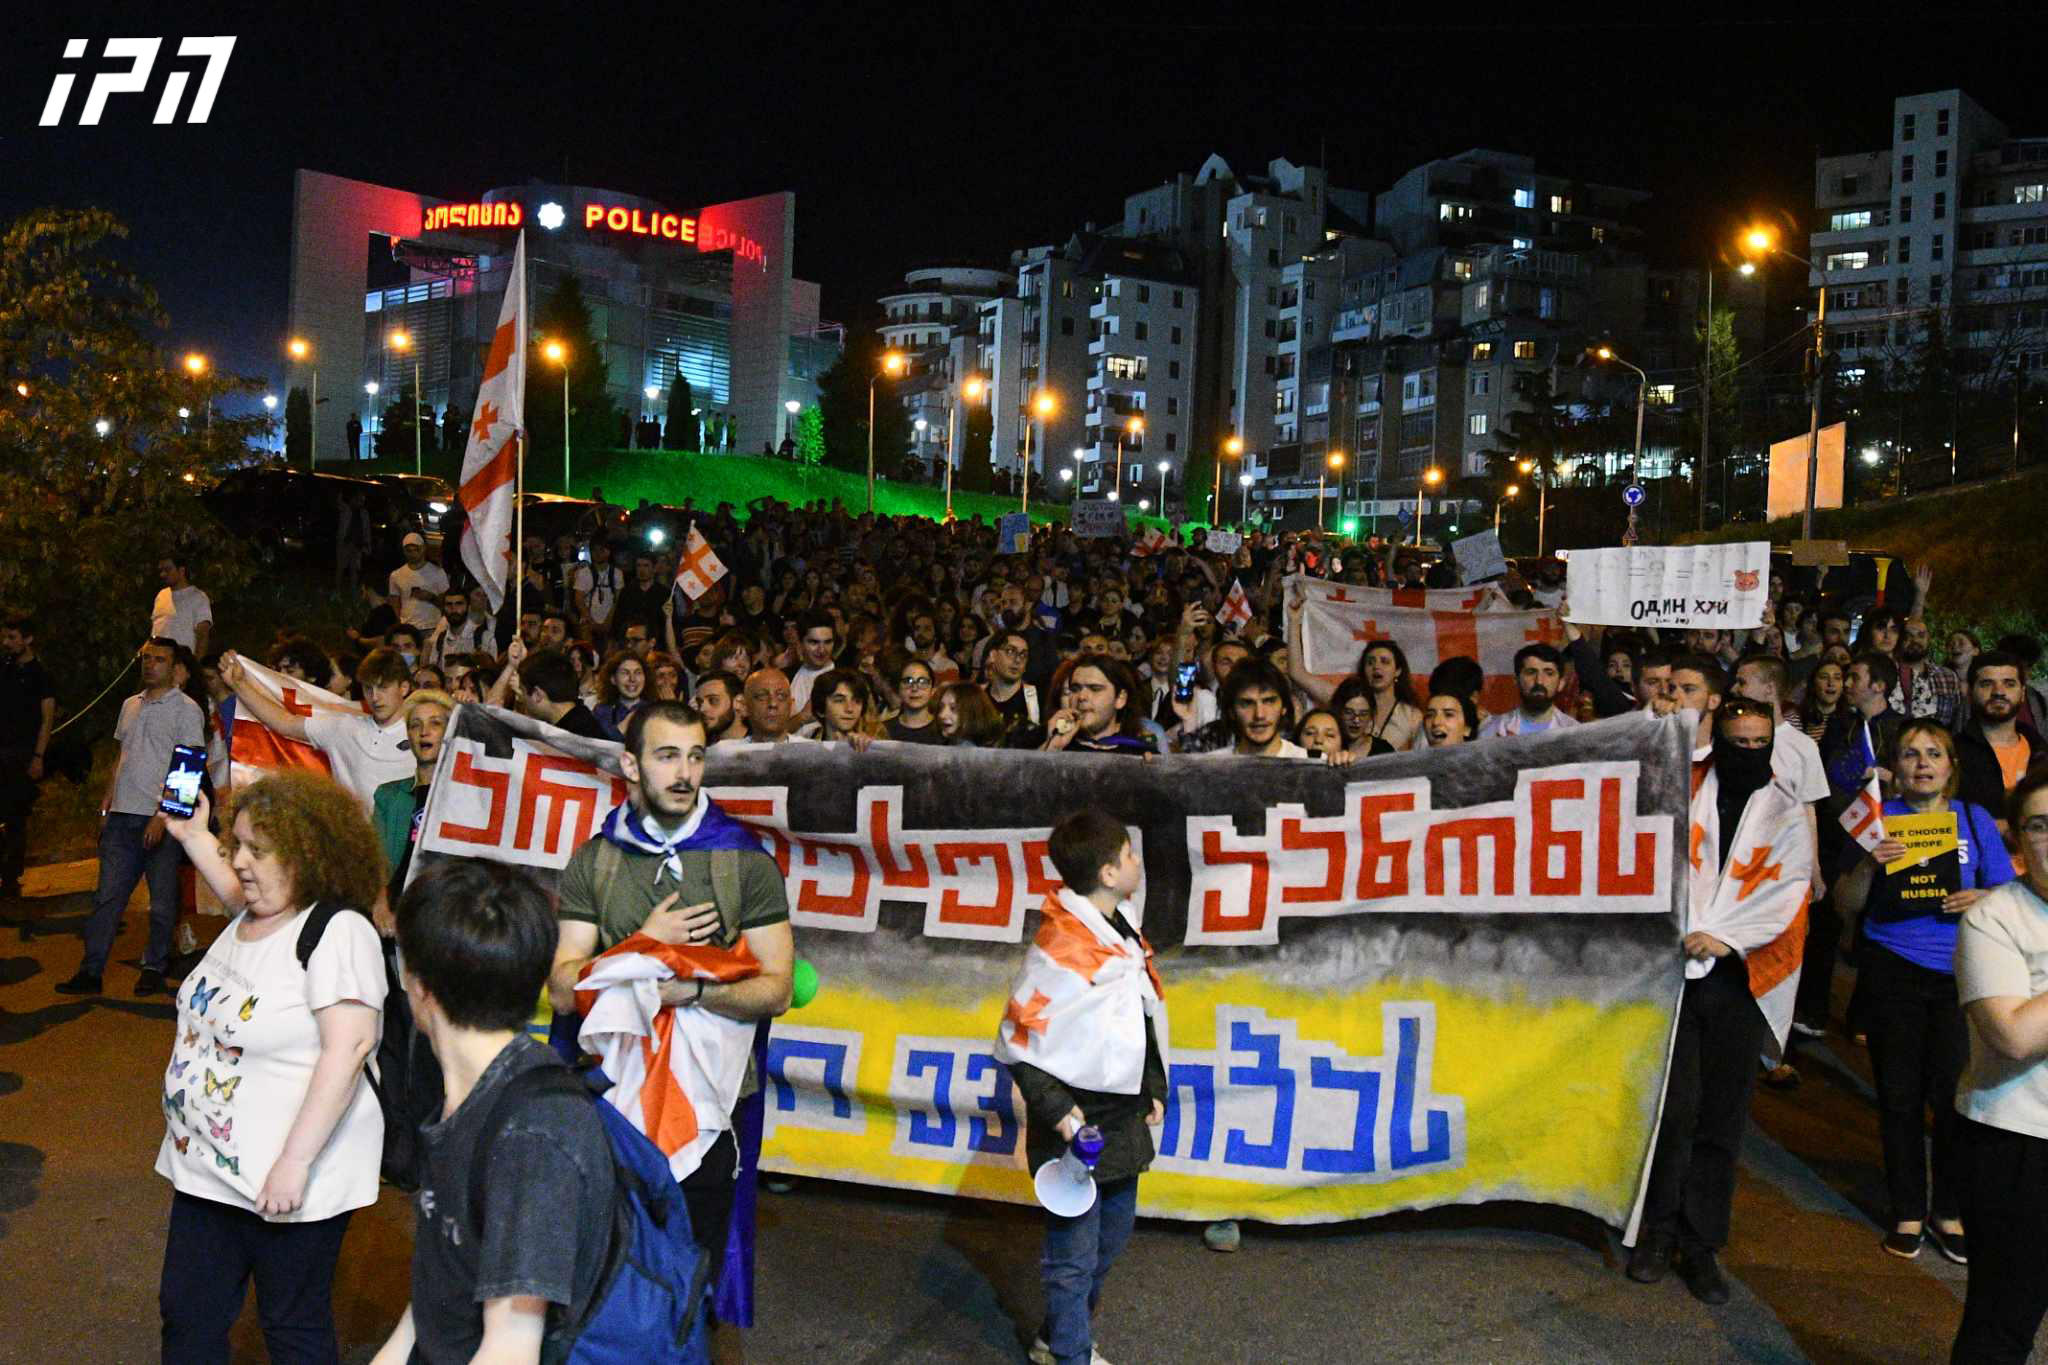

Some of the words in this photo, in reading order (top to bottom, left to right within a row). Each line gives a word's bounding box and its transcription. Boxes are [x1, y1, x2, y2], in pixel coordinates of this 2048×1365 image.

[424, 203, 522, 230] პოლიცია
[585, 205, 696, 242] POLICE
[1631, 598, 1686, 620] ОДИН
[1908, 827, 1953, 837] CHOOSE
[440, 752, 628, 856] არ
[1202, 778, 1656, 931] კანონს
[1905, 840, 1942, 848] UROPE
[1910, 875, 1936, 885] NOT
[1901, 888, 1949, 899] RUSSIA
